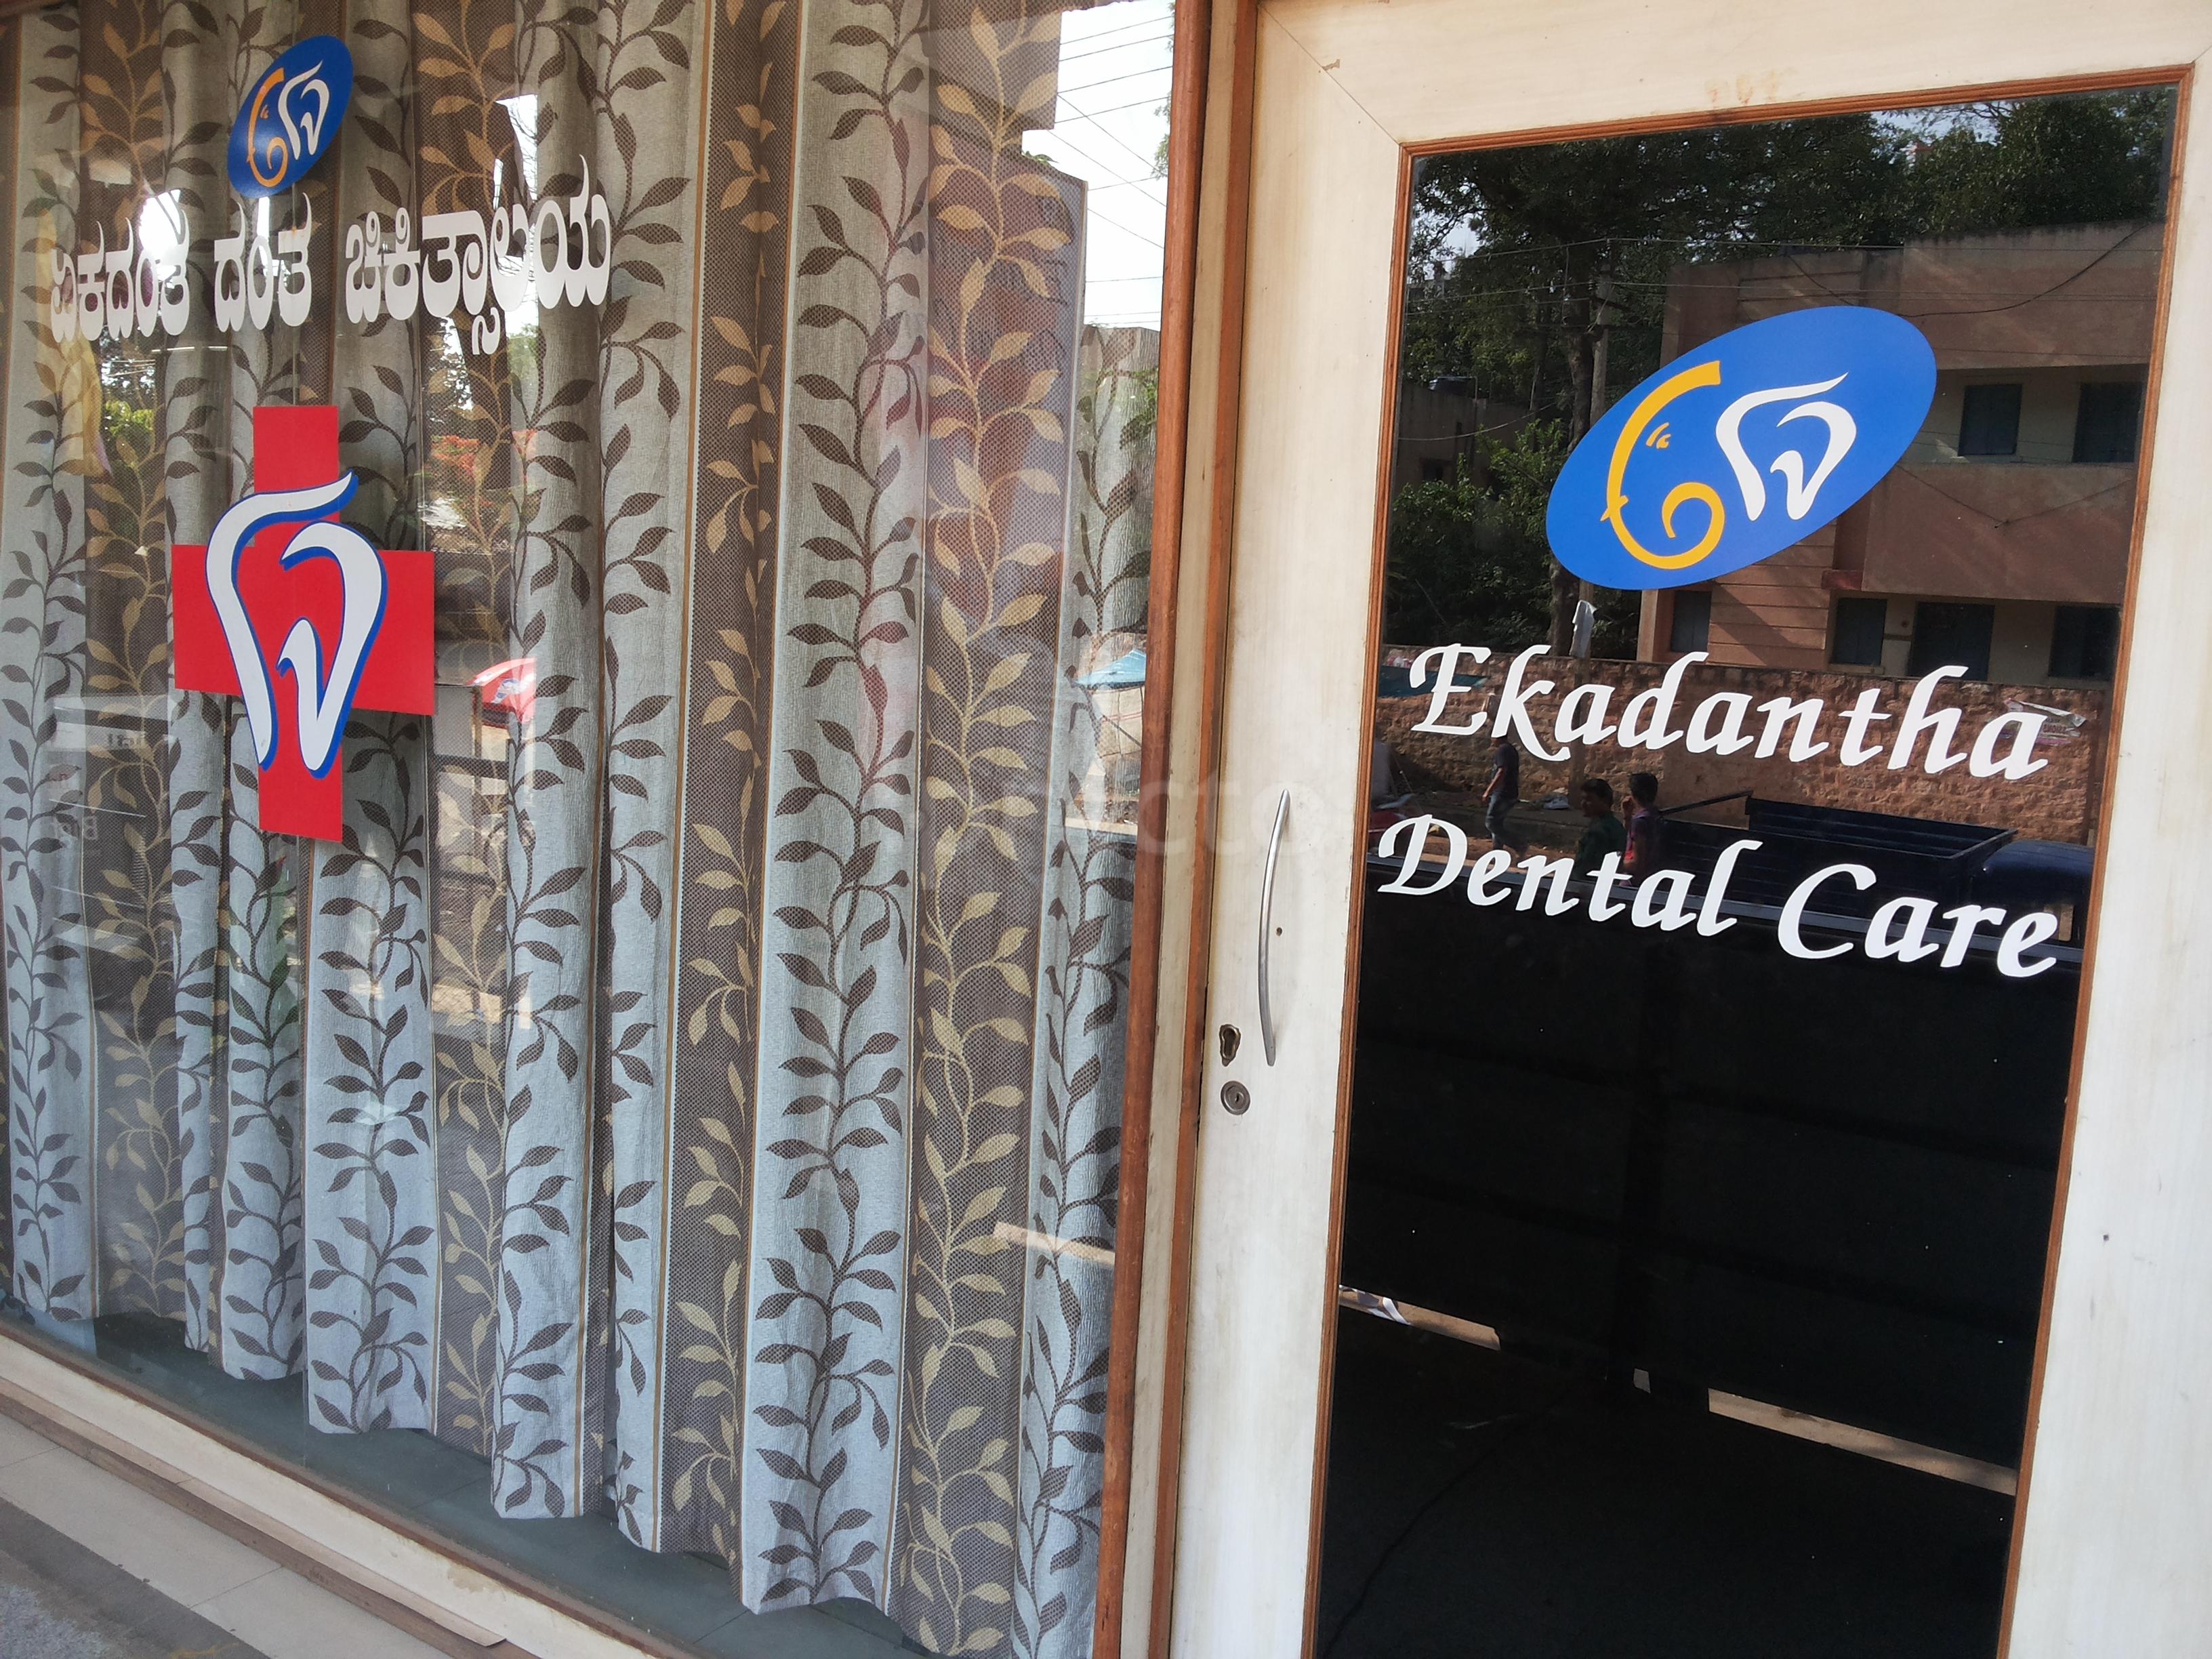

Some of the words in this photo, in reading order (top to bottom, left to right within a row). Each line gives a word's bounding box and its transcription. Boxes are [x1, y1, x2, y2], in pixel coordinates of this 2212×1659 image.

[213, 192, 312, 333] ದಂತ
[346, 154, 611, 356] ಚಿಕಿತ್ಸಾಲಯ
[1409, 643, 2049, 780] Ekadantha
[1377, 814, 1763, 937] Dental
[1777, 863, 2058, 978] Care
